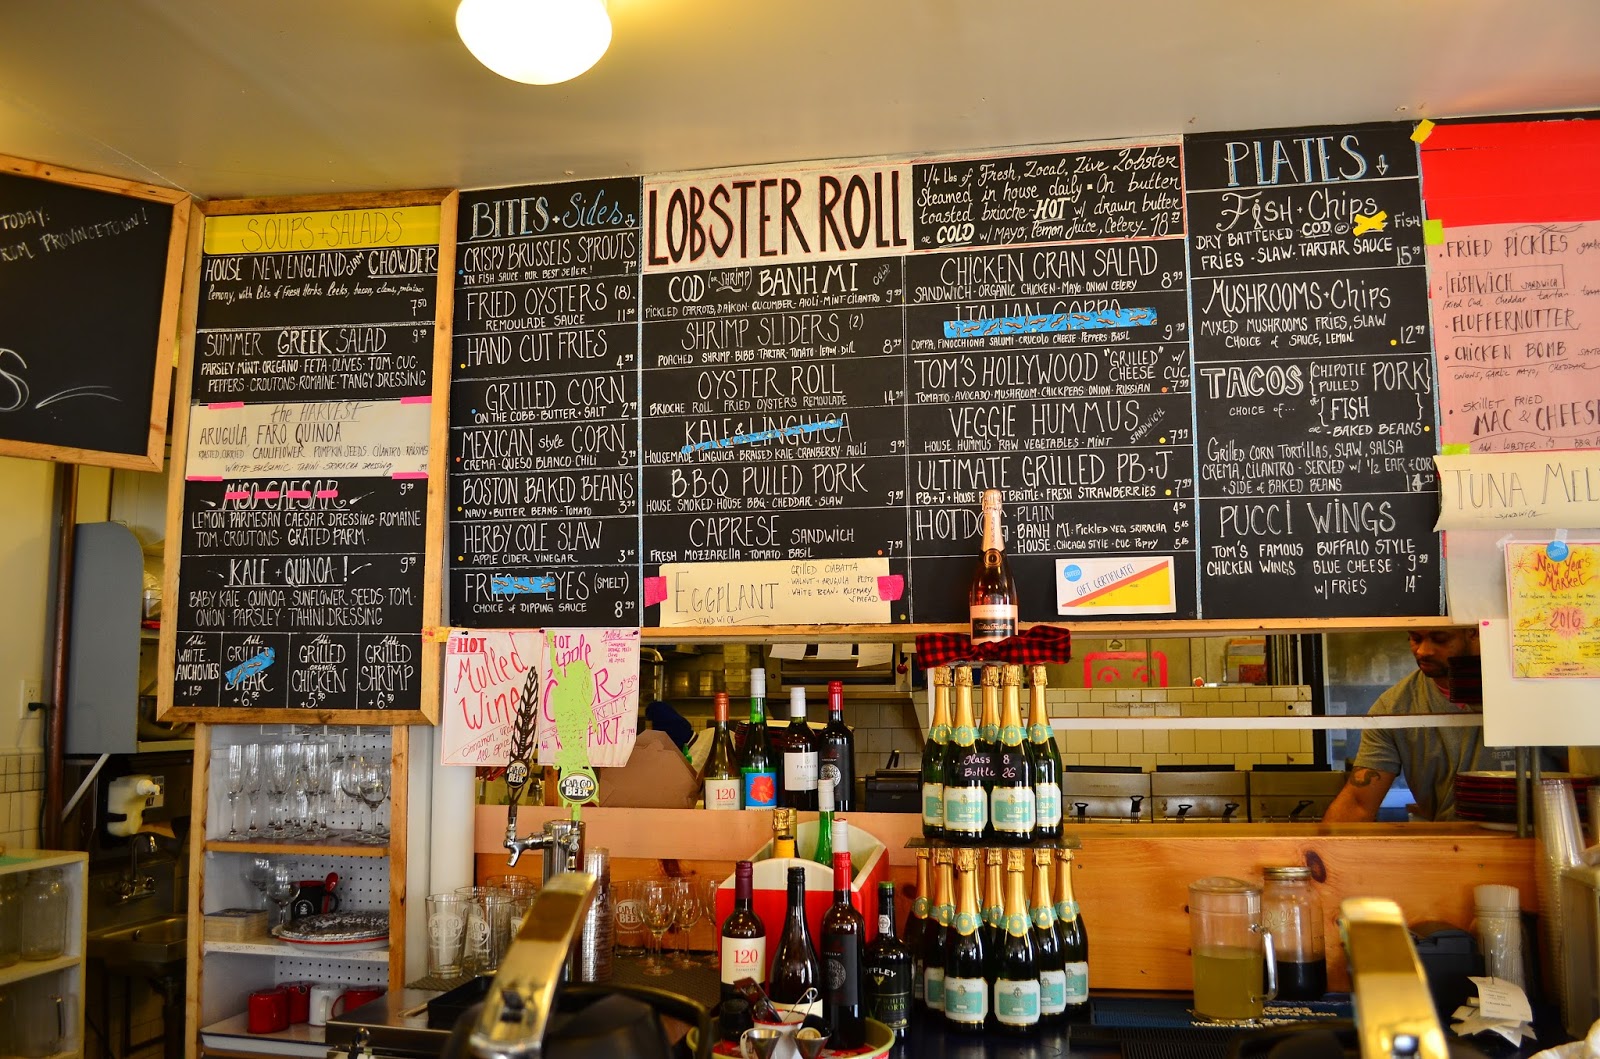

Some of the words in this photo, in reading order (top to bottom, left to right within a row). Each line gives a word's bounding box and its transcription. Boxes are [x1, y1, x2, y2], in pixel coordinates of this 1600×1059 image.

[1224, 135, 1368, 186] PLATES
[917, 184, 973, 207] Steamed
[1003, 180, 1039, 200] house
[470, 196, 550, 240] BITES
[648, 178, 811, 265] LOBSTER
[819, 170, 908, 253] ROLL
[919, 205, 975, 225] toasted
[1034, 198, 1070, 219] HOT
[242, 217, 314, 252] SOUPS
[326, 211, 403, 247] SALADS
[937, 223, 975, 243] COLD
[1196, 234, 1222, 250] DRY
[1227, 227, 1293, 247] BATTERED
[1302, 221, 1331, 236] COD
[464, 245, 504, 272] CRISPY
[508, 239, 571, 270] BRUSSELS
[577, 232, 635, 263] SPROUTS
[1202, 253, 1244, 270] FRIES
[1301, 241, 1347, 257] TARTAR
[1353, 237, 1392, 252] SAUCE
[1447, 235, 1492, 258] FRIED
[1504, 232, 1568, 258] PICKLES
[205, 257, 243, 282] HOUSE
[368, 247, 438, 275] CHOWDER
[941, 252, 1024, 286] CHICKEN
[1033, 250, 1086, 280] CRAN
[1093, 245, 1158, 278] SALAD
[669, 274, 705, 302] COD
[757, 266, 816, 297] BANH
[1451, 272, 1513, 294] FISHWICH
[467, 291, 516, 321] FRIED
[525, 283, 608, 316] OYSTERS
[1202, 279, 1323, 317] MUSHROOMS
[486, 318, 546, 331] REMOULADE
[554, 314, 585, 325] SAUCE
[645, 307, 678, 319] PICKLED
[1201, 320, 1238, 335] MIXED
[1247, 317, 1308, 332] MUSHROOMS
[1353, 313, 1387, 329] SLAW
[204, 332, 263, 356] SUMMER
[277, 329, 332, 354] GREEK
[336, 328, 386, 353] SALAD
[682, 318, 749, 350] SHRIMP
[758, 313, 840, 348] SLIDERS
[1326, 332, 1354, 344] LEMON
[468, 336, 512, 366] HAND
[520, 332, 553, 362] CUT
[558, 329, 608, 359] FRIES
[1455, 343, 1511, 361] CHICKEN
[1525, 341, 1567, 358] BOMB
[658, 354, 693, 366] POACHED
[914, 355, 976, 388] TOM'S
[982, 352, 1098, 387] HOLLYWOOD
[340, 373, 374, 389] TANGY
[375, 370, 427, 387] DRESSING
[698, 367, 785, 400] OYSTER
[791, 364, 842, 396] ROLL
[1108, 366, 1156, 381] CHEESE
[1200, 364, 1304, 399] TACOS
[486, 381, 556, 413] GRILLED
[568, 375, 625, 406] CORN
[584, 406, 606, 418] SALT
[650, 402, 685, 416] BRIOCHE
[693, 402, 713, 413] ROLL
[724, 398, 750, 412] FRIED
[756, 398, 797, 412] OYSTERS
[1331, 396, 1370, 420] FISH
[949, 403, 1016, 440] VEGGIE
[1032, 400, 1140, 435] HUMMUS
[1378, 422, 1422, 435] BEANS
[1473, 409, 1512, 435] MAC
[461, 428, 533, 459] MEXICAN
[572, 424, 625, 453] CORN
[924, 440, 952, 452] HOUSE
[998, 438, 1020, 449] RAW
[1024, 438, 1079, 449] VEGETABLES
[1250, 446, 1274, 460] CORN
[1370, 440, 1403, 454] SALSA
[917, 456, 1010, 491] ULTIMATE
[1022, 452, 1105, 488] GRILLED
[1305, 459, 1344, 475] SERVED
[463, 477, 518, 505] BOSTON
[524, 476, 575, 503] BAKED
[581, 473, 633, 501] BEANS
[743, 465, 803, 496] PULLED
[813, 463, 869, 494] PORK
[1445, 469, 1527, 510] TUNA
[1542, 463, 1600, 504] MEL
[1078, 486, 1156, 498] STRAWBERRIES
[646, 500, 671, 513] HOUSE
[193, 512, 224, 529] LEMON
[230, 511, 281, 528] PARMESAN
[285, 513, 324, 527] CAESAR
[328, 511, 374, 527] DRESSING
[379, 508, 421, 527] ROMAINE
[1220, 500, 1293, 538] PUCCI
[1307, 499, 1396, 537] WINGS
[288, 530, 330, 546] GRATED
[464, 524, 514, 553] HERBY
[516, 522, 548, 551] COLE
[558, 522, 602, 551] SLAW
[689, 515, 780, 547] CAPRESE
[790, 525, 854, 544] SANDWICH
[472, 553, 498, 564] APPLE
[502, 553, 532, 563] CIDER
[534, 553, 578, 563] VINEGAR
[651, 551, 677, 562] FRESH
[1259, 543, 1303, 558] FAMOUS
[1317, 540, 1369, 556] BUFFALO
[1375, 539, 1415, 554] STYLE
[230, 559, 270, 586] KALE
[1313, 560, 1341, 574] BLUE
[1347, 559, 1393, 573] CHEESE
[189, 591, 217, 607] BABY
[351, 588, 384, 605] SEEDS
[1076, 580, 1091, 597] GIFT
[196, 608, 226, 626] ONION
[233, 608, 281, 626] PARSLEY
[326, 606, 383, 626] DRESSING
[473, 603, 503, 613] CHOICE
[520, 602, 553, 613] DIPPING
[558, 602, 587, 612] SAUCE
[1550, 610, 1581, 628] 2016
[365, 644, 412, 663] GRILLED
[457, 638, 486, 653] HOT
[175, 663, 220, 681] ANCHOVIES
[454, 632, 528, 693] Mulled
[292, 669, 348, 692] CHICKEN
[358, 664, 414, 692] SHRIMP
[459, 686, 521, 730] Wine
[1003, 754, 1009, 764] 8
[1002, 768, 1016, 778] 26
[565, 787, 589, 796] BEER
[716, 788, 736, 799] 120
[734, 949, 758, 964] 120
